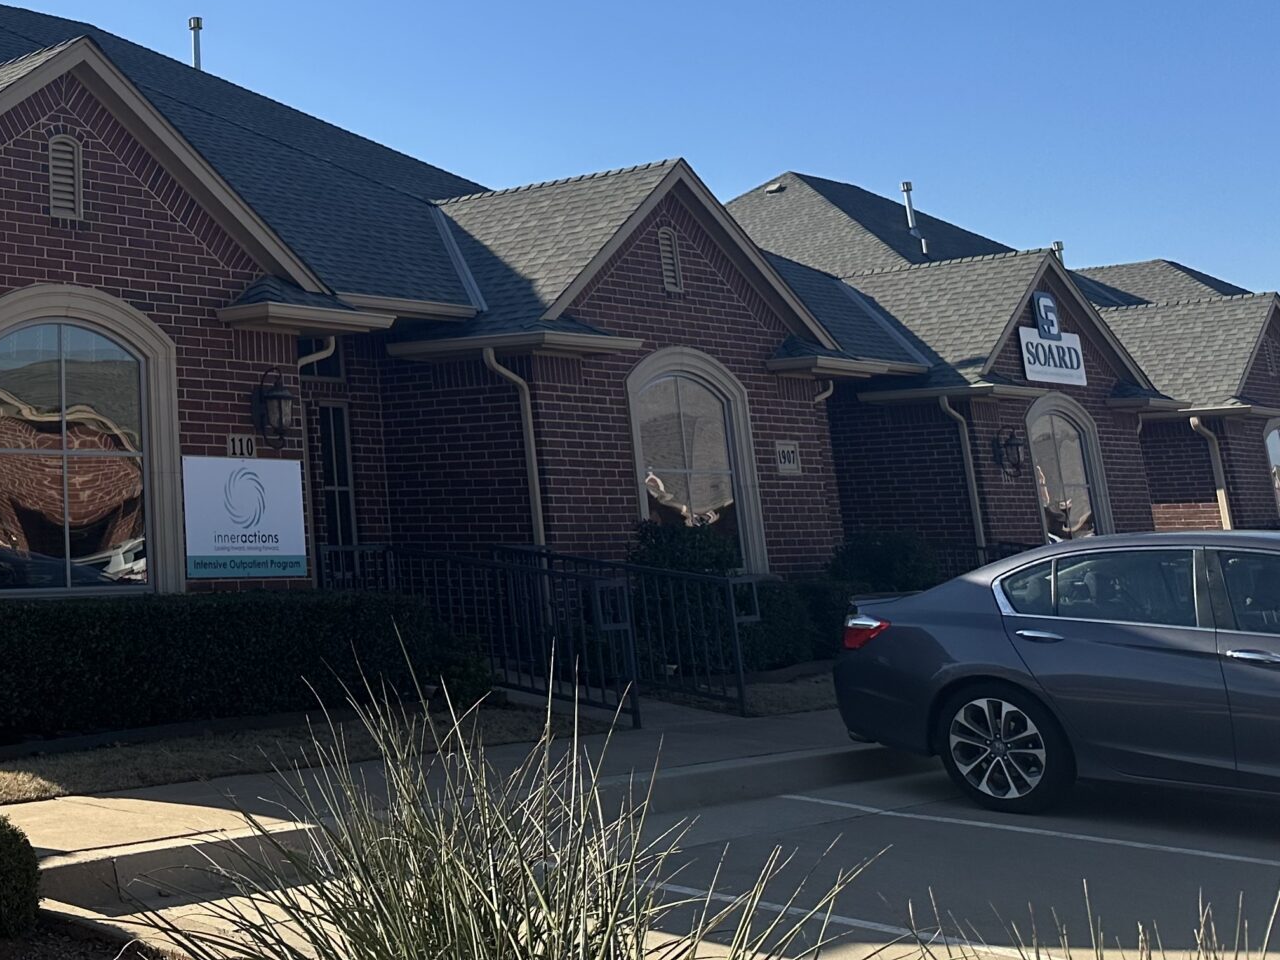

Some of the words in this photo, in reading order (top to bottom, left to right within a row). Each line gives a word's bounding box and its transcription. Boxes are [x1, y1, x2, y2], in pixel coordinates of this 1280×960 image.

[1025, 341, 1081, 370] SOARD
[231, 437, 254, 456] 110
[778, 450, 795, 464] 1907
[214, 531, 279, 543] inneractions
[194, 559, 227, 570] Intensive
[229, 559, 268, 570] Outpatient
[270, 559, 301, 571] Program
